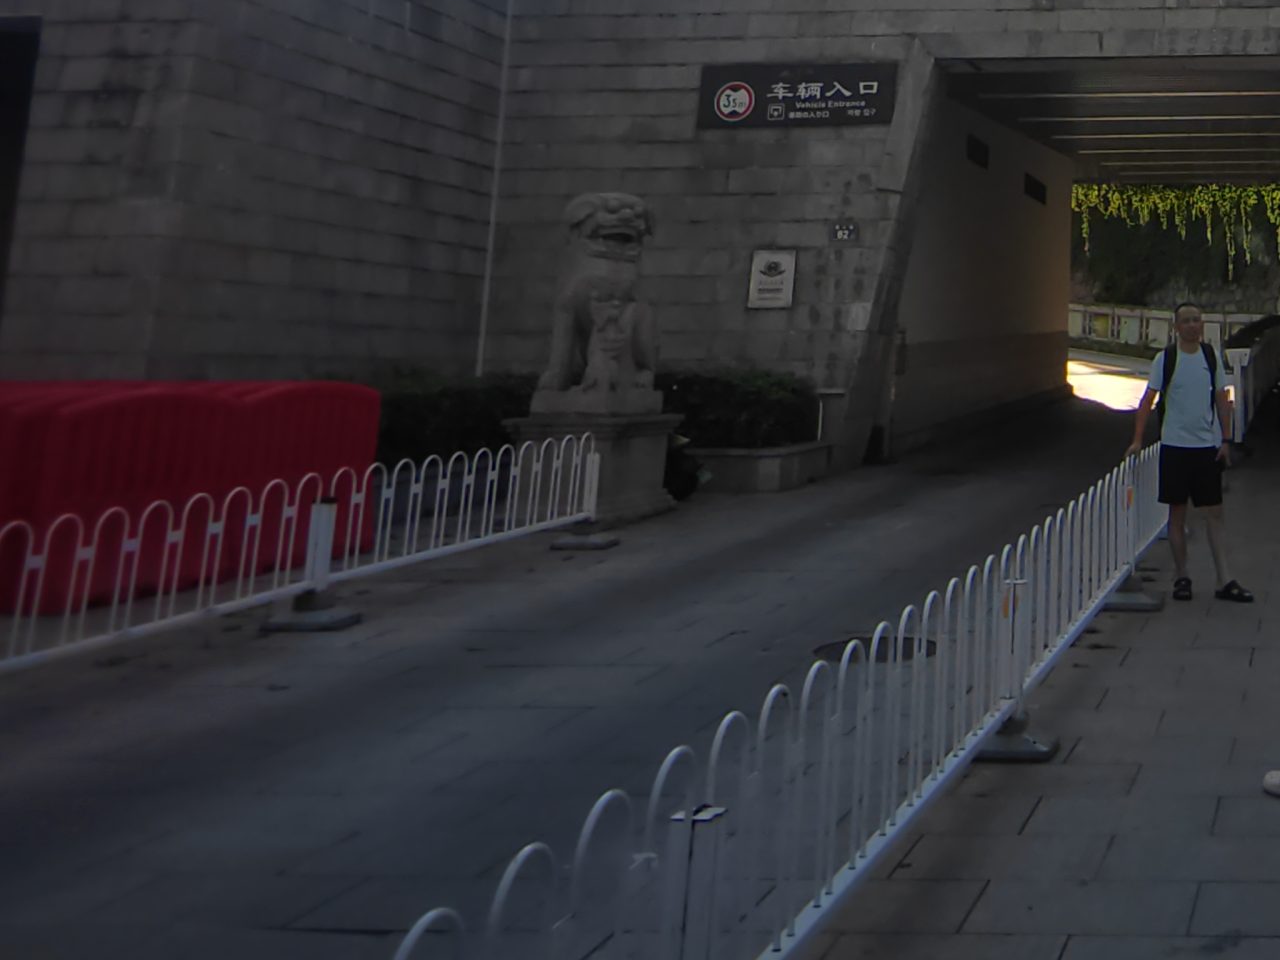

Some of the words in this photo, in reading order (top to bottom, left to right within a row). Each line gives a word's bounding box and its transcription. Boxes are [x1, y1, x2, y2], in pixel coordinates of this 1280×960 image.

[766, 81, 879, 100] 车辆入口
[795, 101, 826, 109] Vehicle
[827, 100, 866, 108] Entrance
